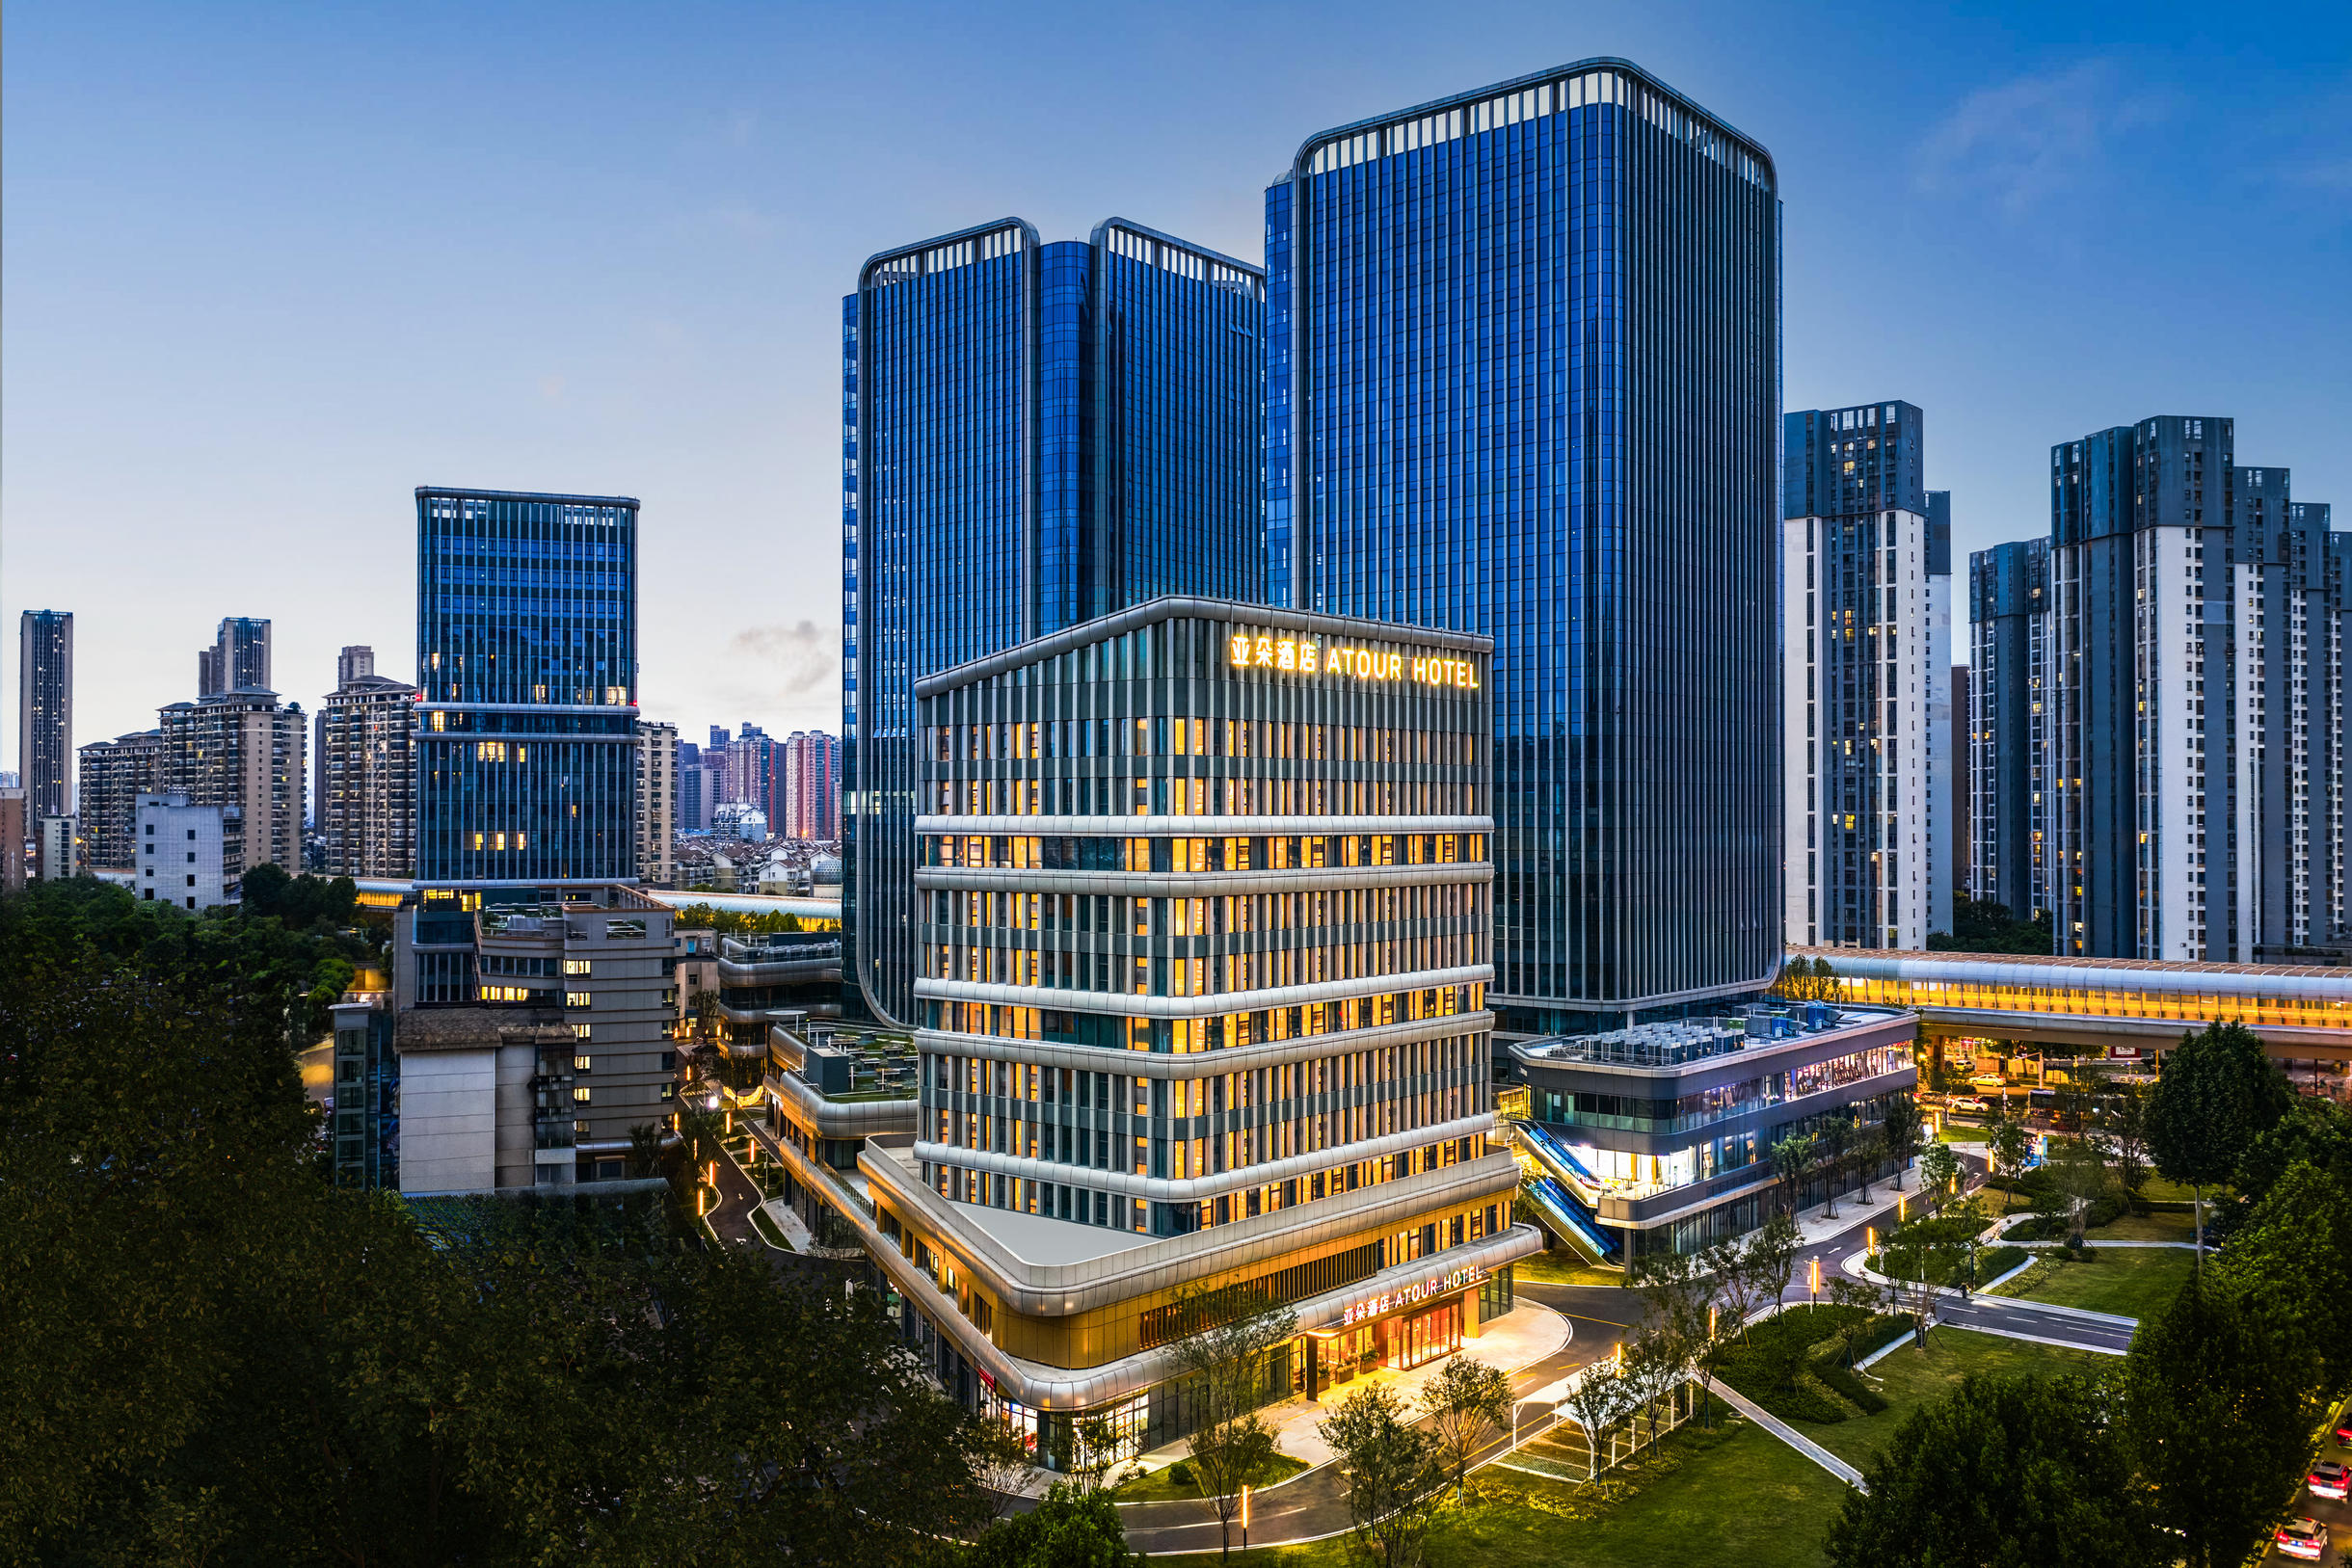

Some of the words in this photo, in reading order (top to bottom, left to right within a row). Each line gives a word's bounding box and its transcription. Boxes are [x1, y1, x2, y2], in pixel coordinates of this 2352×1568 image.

[1232, 636, 1317, 672] 亚朵酒店
[1326, 649, 1402, 680] ATOUR
[1413, 657, 1479, 688] HOTEL
[1343, 1294, 1390, 1325] 亚朵酒店
[1395, 1279, 1437, 1308] ATOUR
[1443, 1264, 1483, 1291] HOTEL
